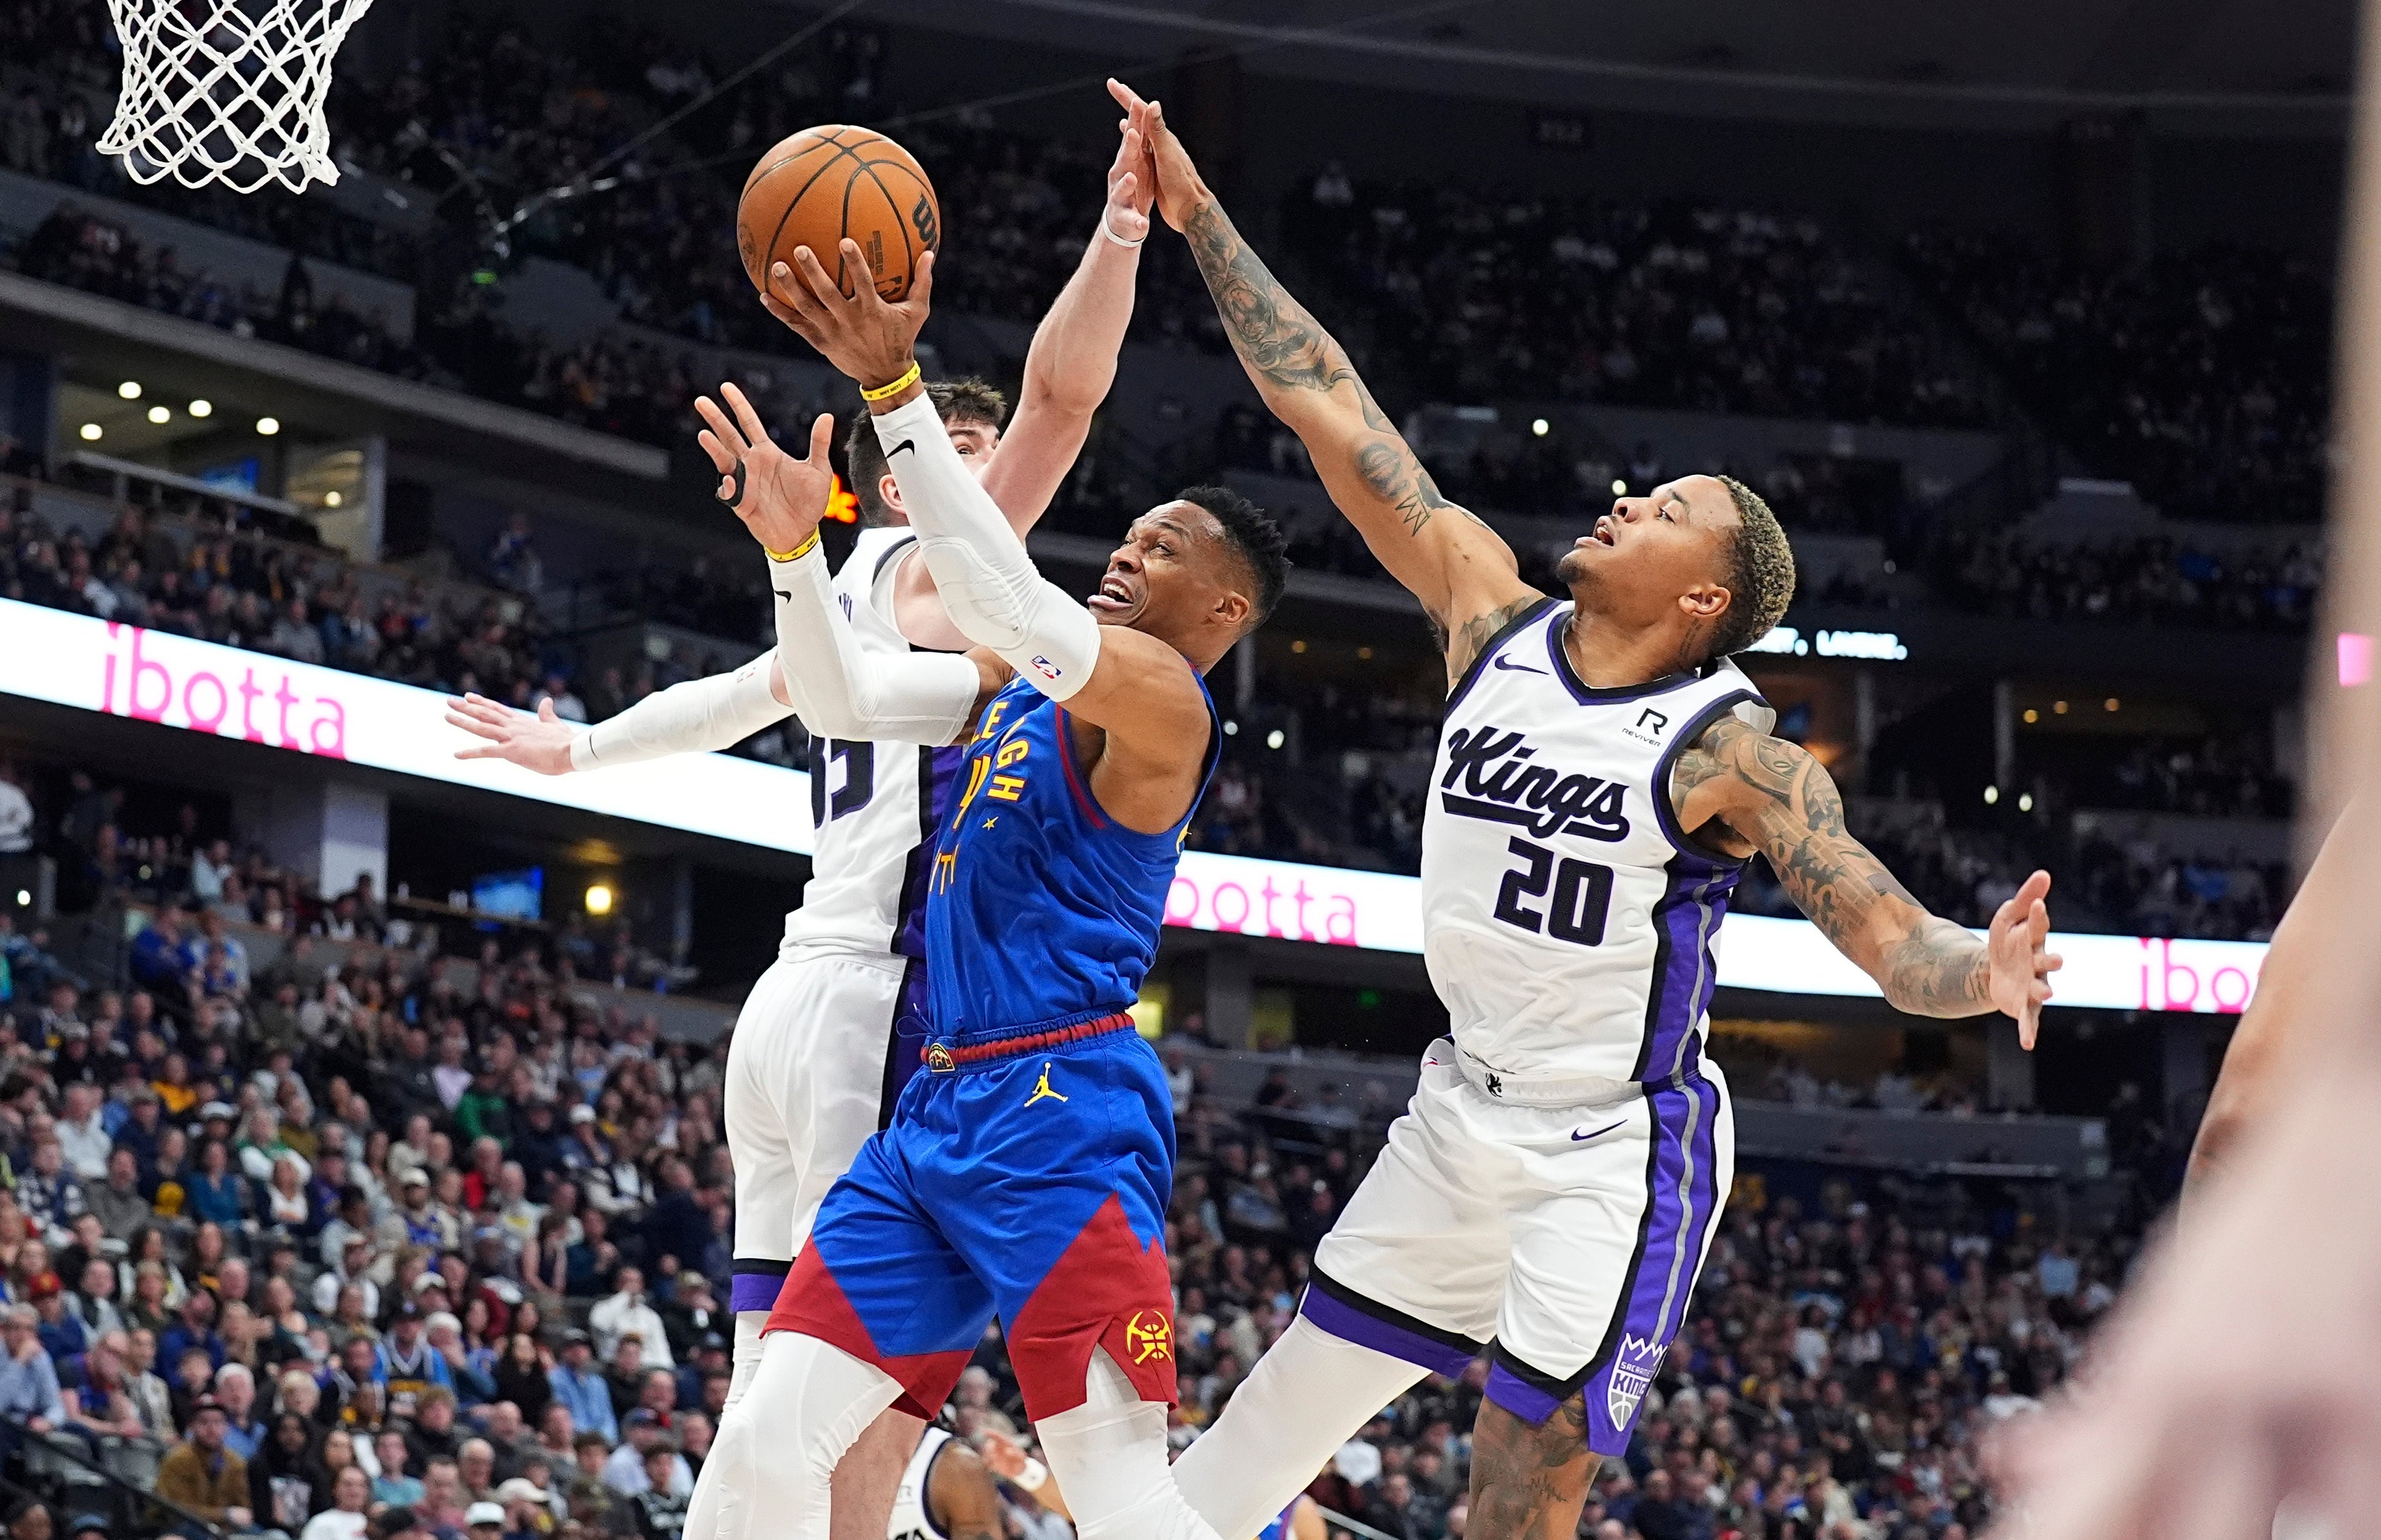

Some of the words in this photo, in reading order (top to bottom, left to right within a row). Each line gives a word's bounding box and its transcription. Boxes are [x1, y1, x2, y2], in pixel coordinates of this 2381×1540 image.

[100, 621, 347, 760] ibotta
[1636, 707, 1668, 735] R
[1622, 728, 1661, 747] REVIVER
[1441, 725, 1630, 842] Kings
[1162, 875, 1358, 947] botta
[1494, 835, 1614, 947] 20
[2138, 937, 2251, 1014] ibo
[1612, 1372, 1649, 1397] KING
